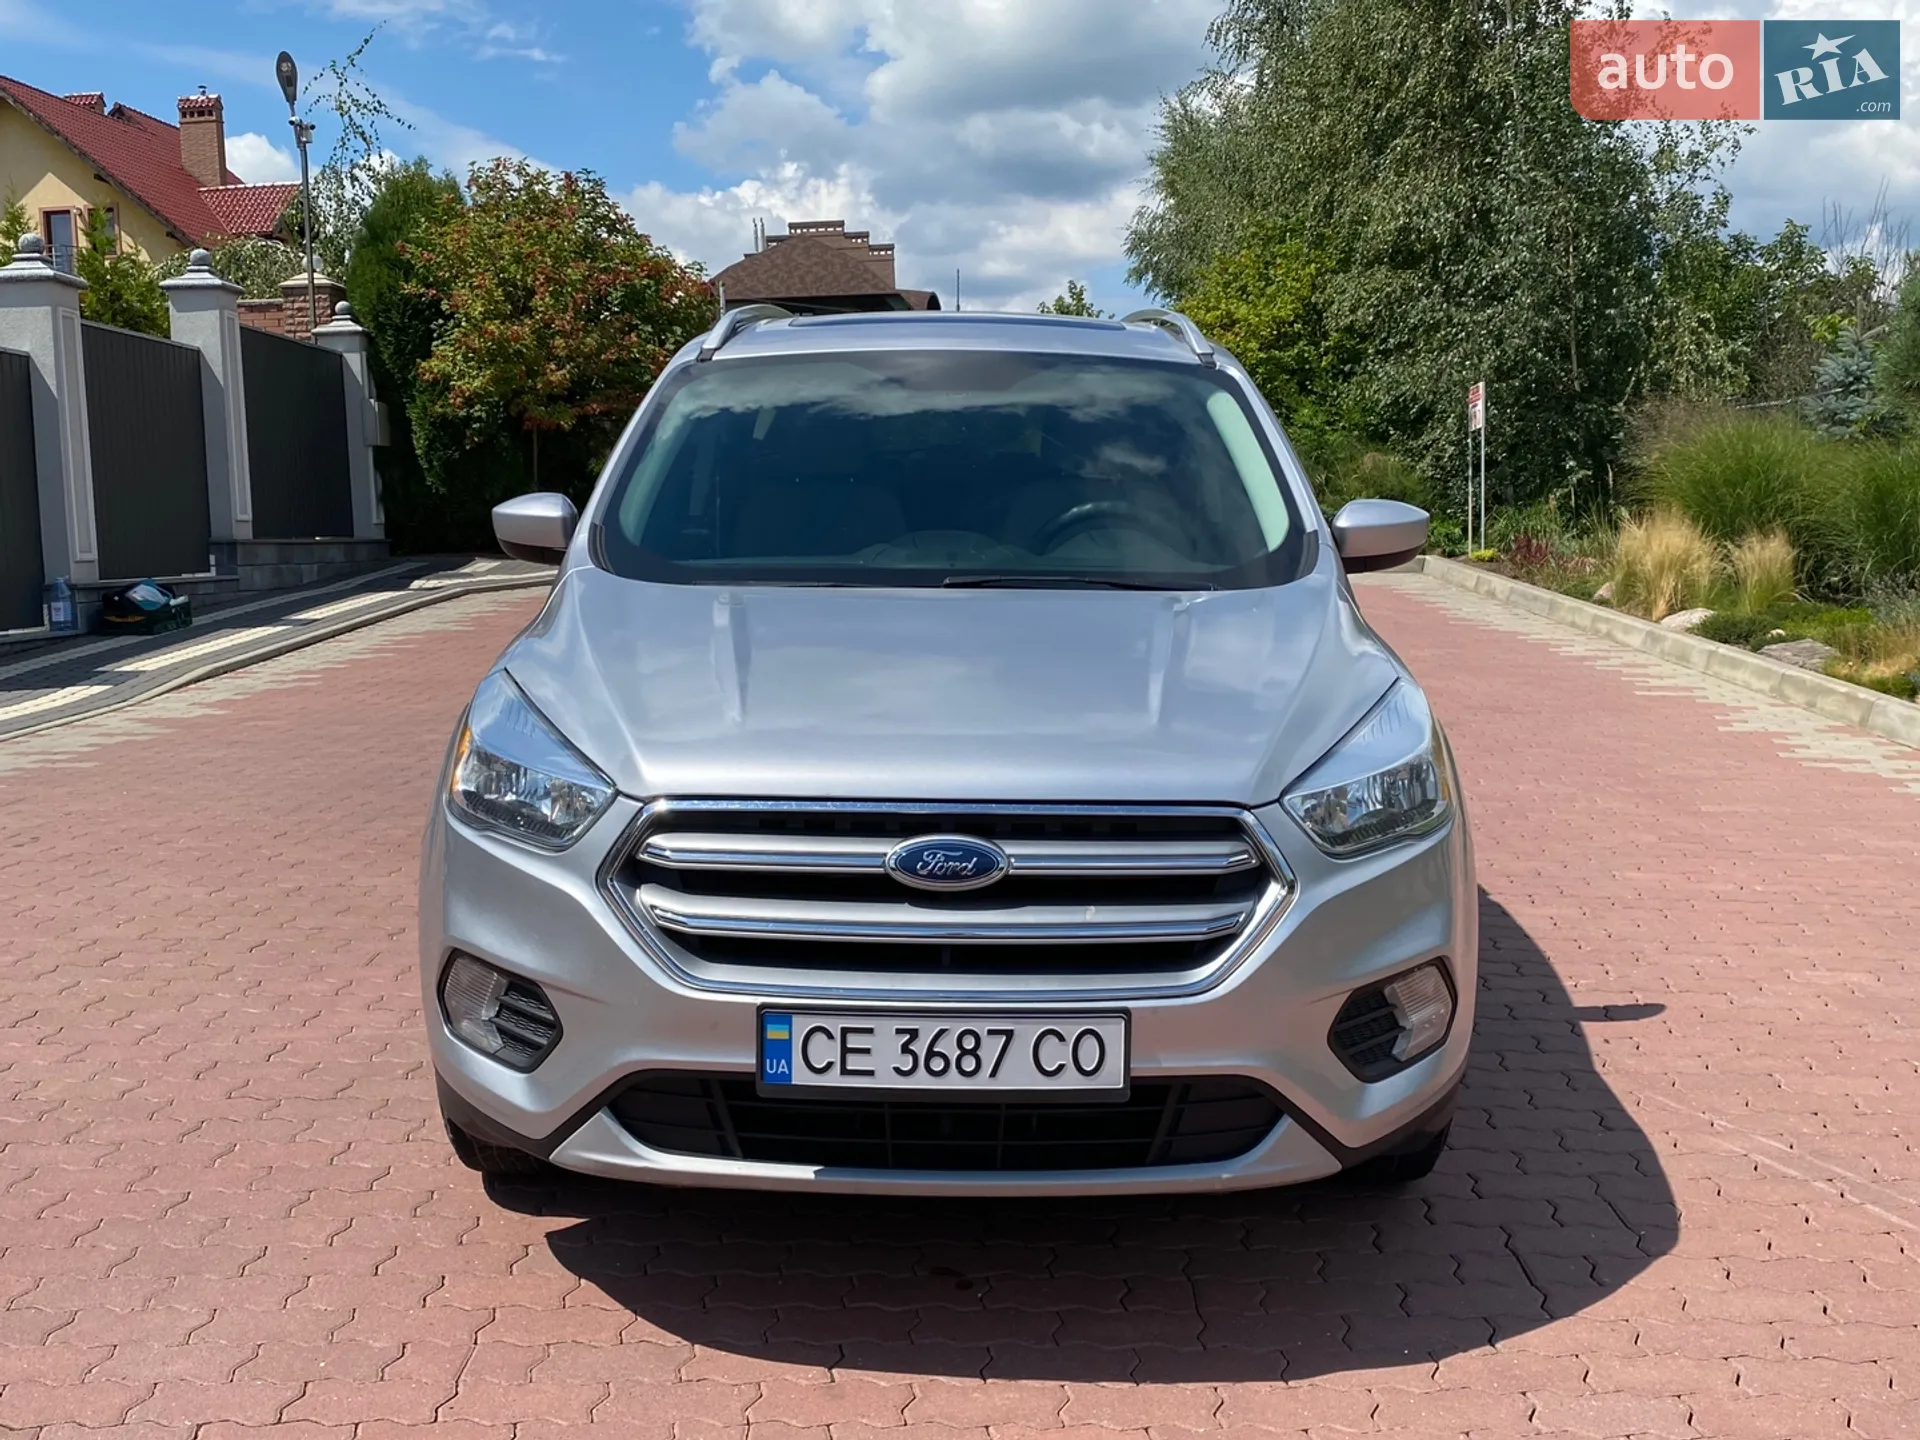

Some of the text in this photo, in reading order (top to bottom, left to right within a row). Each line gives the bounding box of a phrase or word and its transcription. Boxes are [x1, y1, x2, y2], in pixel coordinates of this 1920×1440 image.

[916, 850, 978, 876] Ford
[800, 1024, 1107, 1078] CE 3687 CO
[766, 1058, 790, 1075] UA
